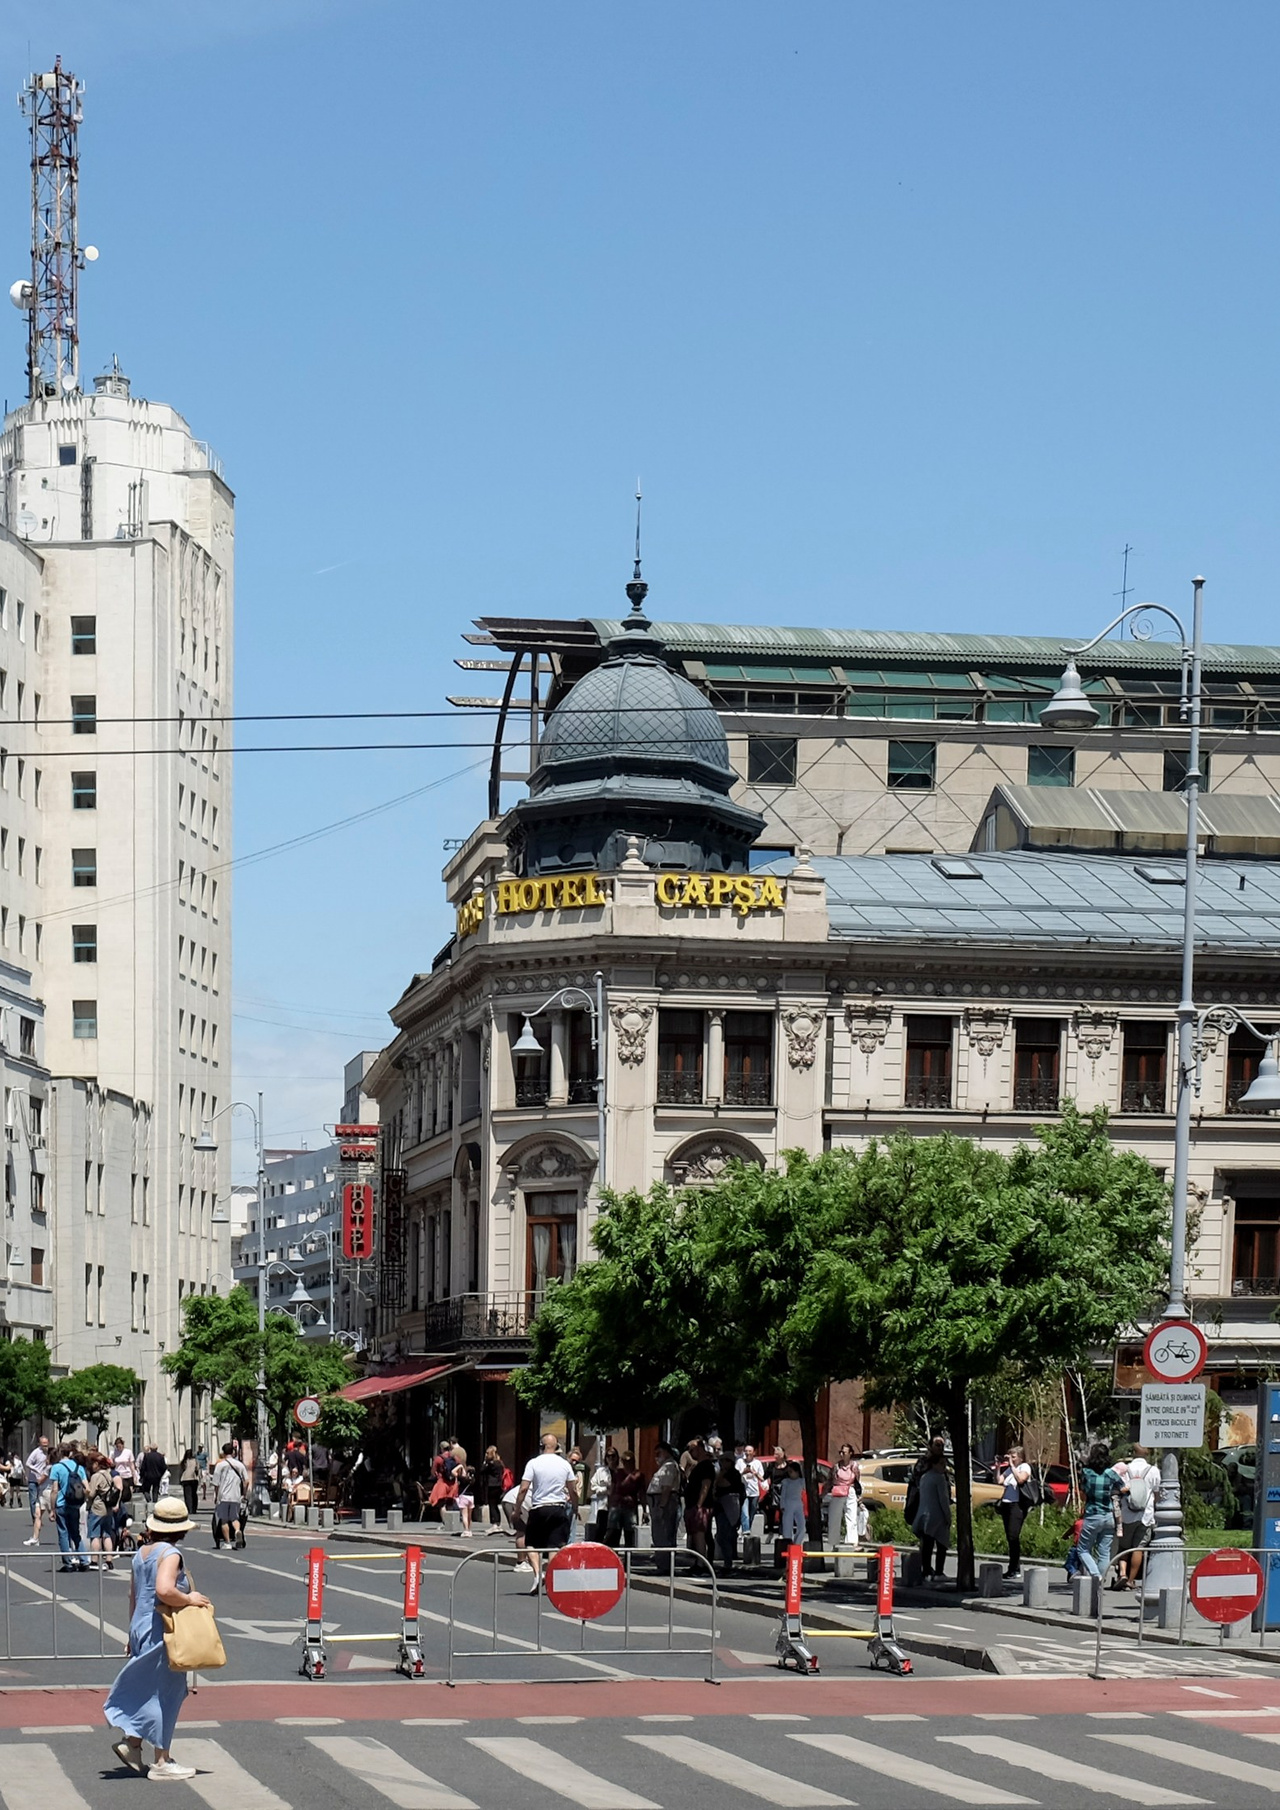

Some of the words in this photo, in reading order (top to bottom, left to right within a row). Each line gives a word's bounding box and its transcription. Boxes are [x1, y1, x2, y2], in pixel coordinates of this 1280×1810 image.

[496, 873, 606, 914] HOTEL
[351, 1184, 365, 1258] HOTEL
[311, 1562, 320, 1601] PITAGONE
[409, 1561, 417, 1600] PITAGONE
[791, 1559, 799, 1597] PITAGONE
[883, 1556, 891, 1595] PITAGONE
